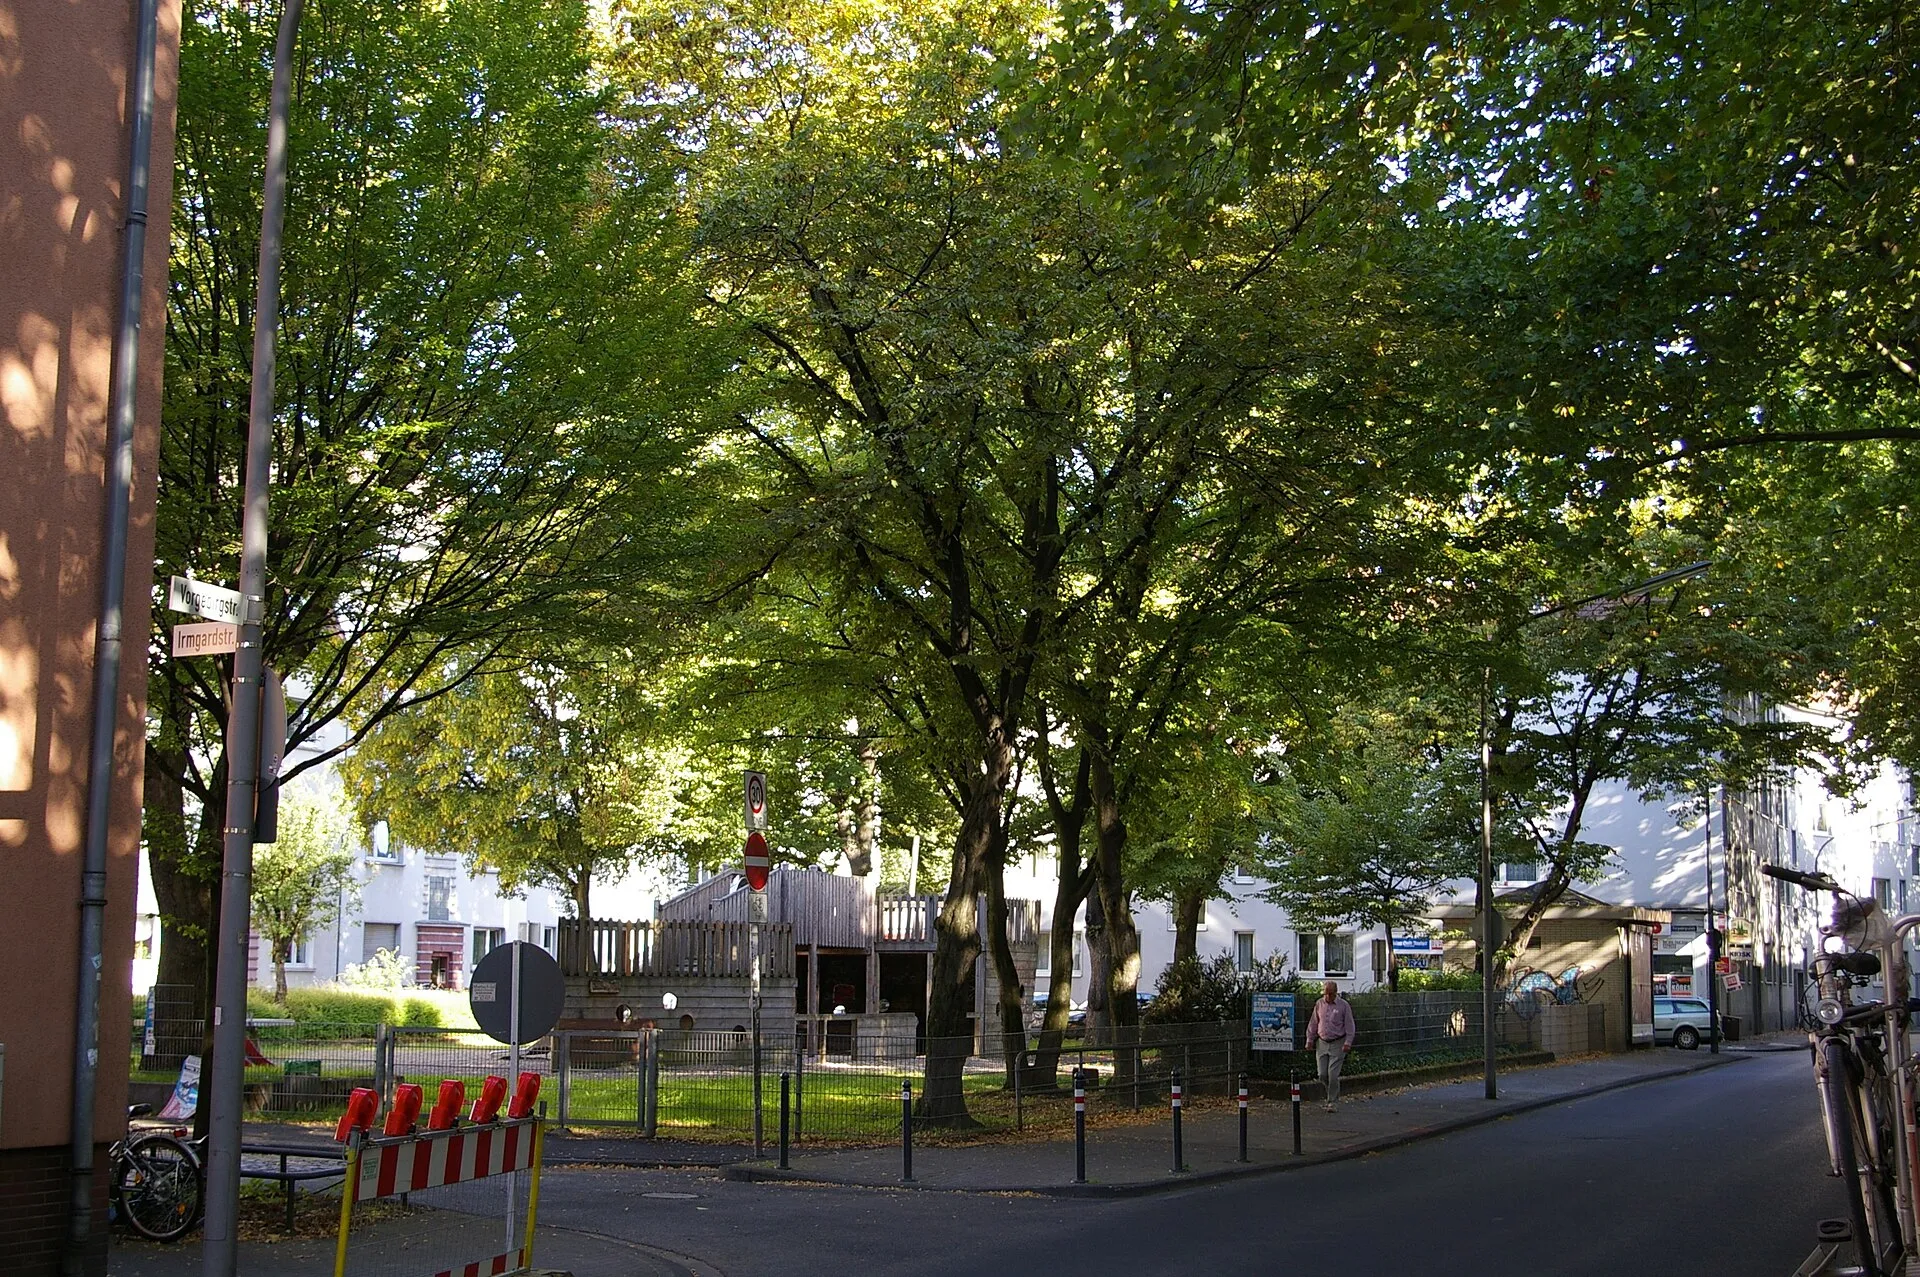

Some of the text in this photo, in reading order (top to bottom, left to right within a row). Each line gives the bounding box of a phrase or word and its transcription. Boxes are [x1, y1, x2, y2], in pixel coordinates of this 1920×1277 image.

[180, 584, 239, 617] Vorgebirgstr.
[178, 628, 235, 651] Irmgardstr.
[751, 786, 761, 804] 30
